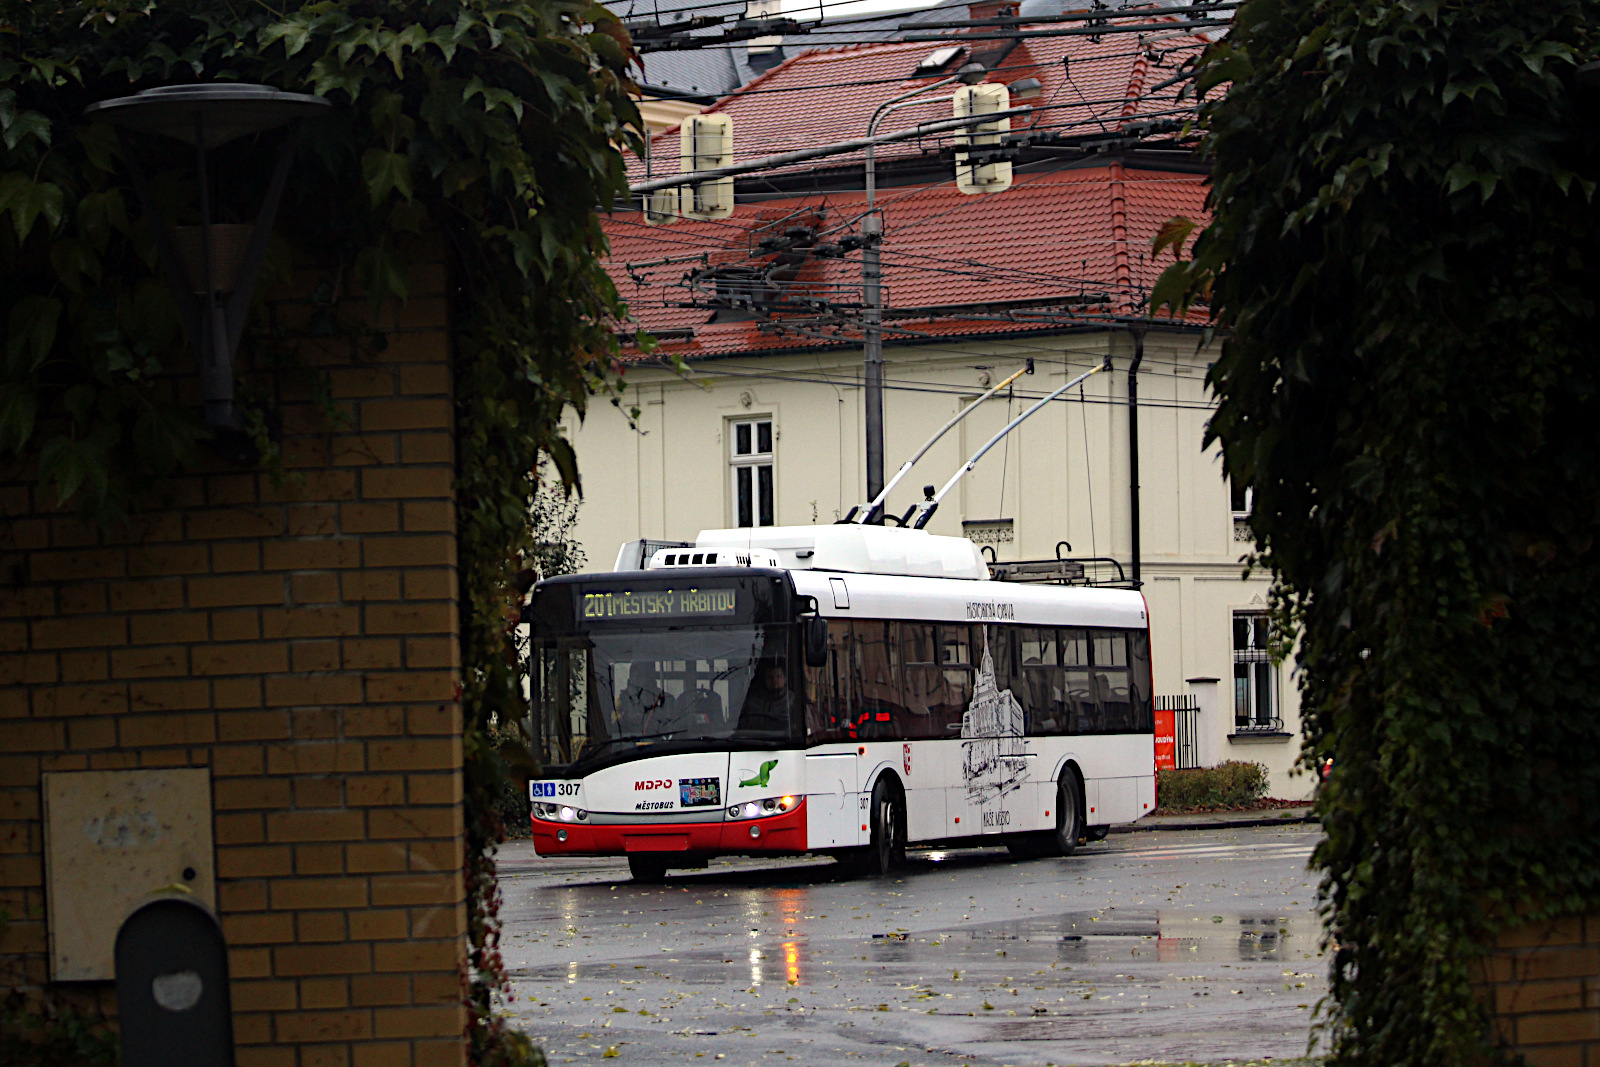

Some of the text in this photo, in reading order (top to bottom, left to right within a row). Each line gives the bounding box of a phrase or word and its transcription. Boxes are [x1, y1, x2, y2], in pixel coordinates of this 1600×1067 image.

[584, 594, 612, 617] 201
[612, 591, 674, 615] MĚSTSKÝ
[558, 783, 581, 796] 307
[634, 779, 673, 791] MDPO
[635, 800, 674, 810] MĚSTOBUS
